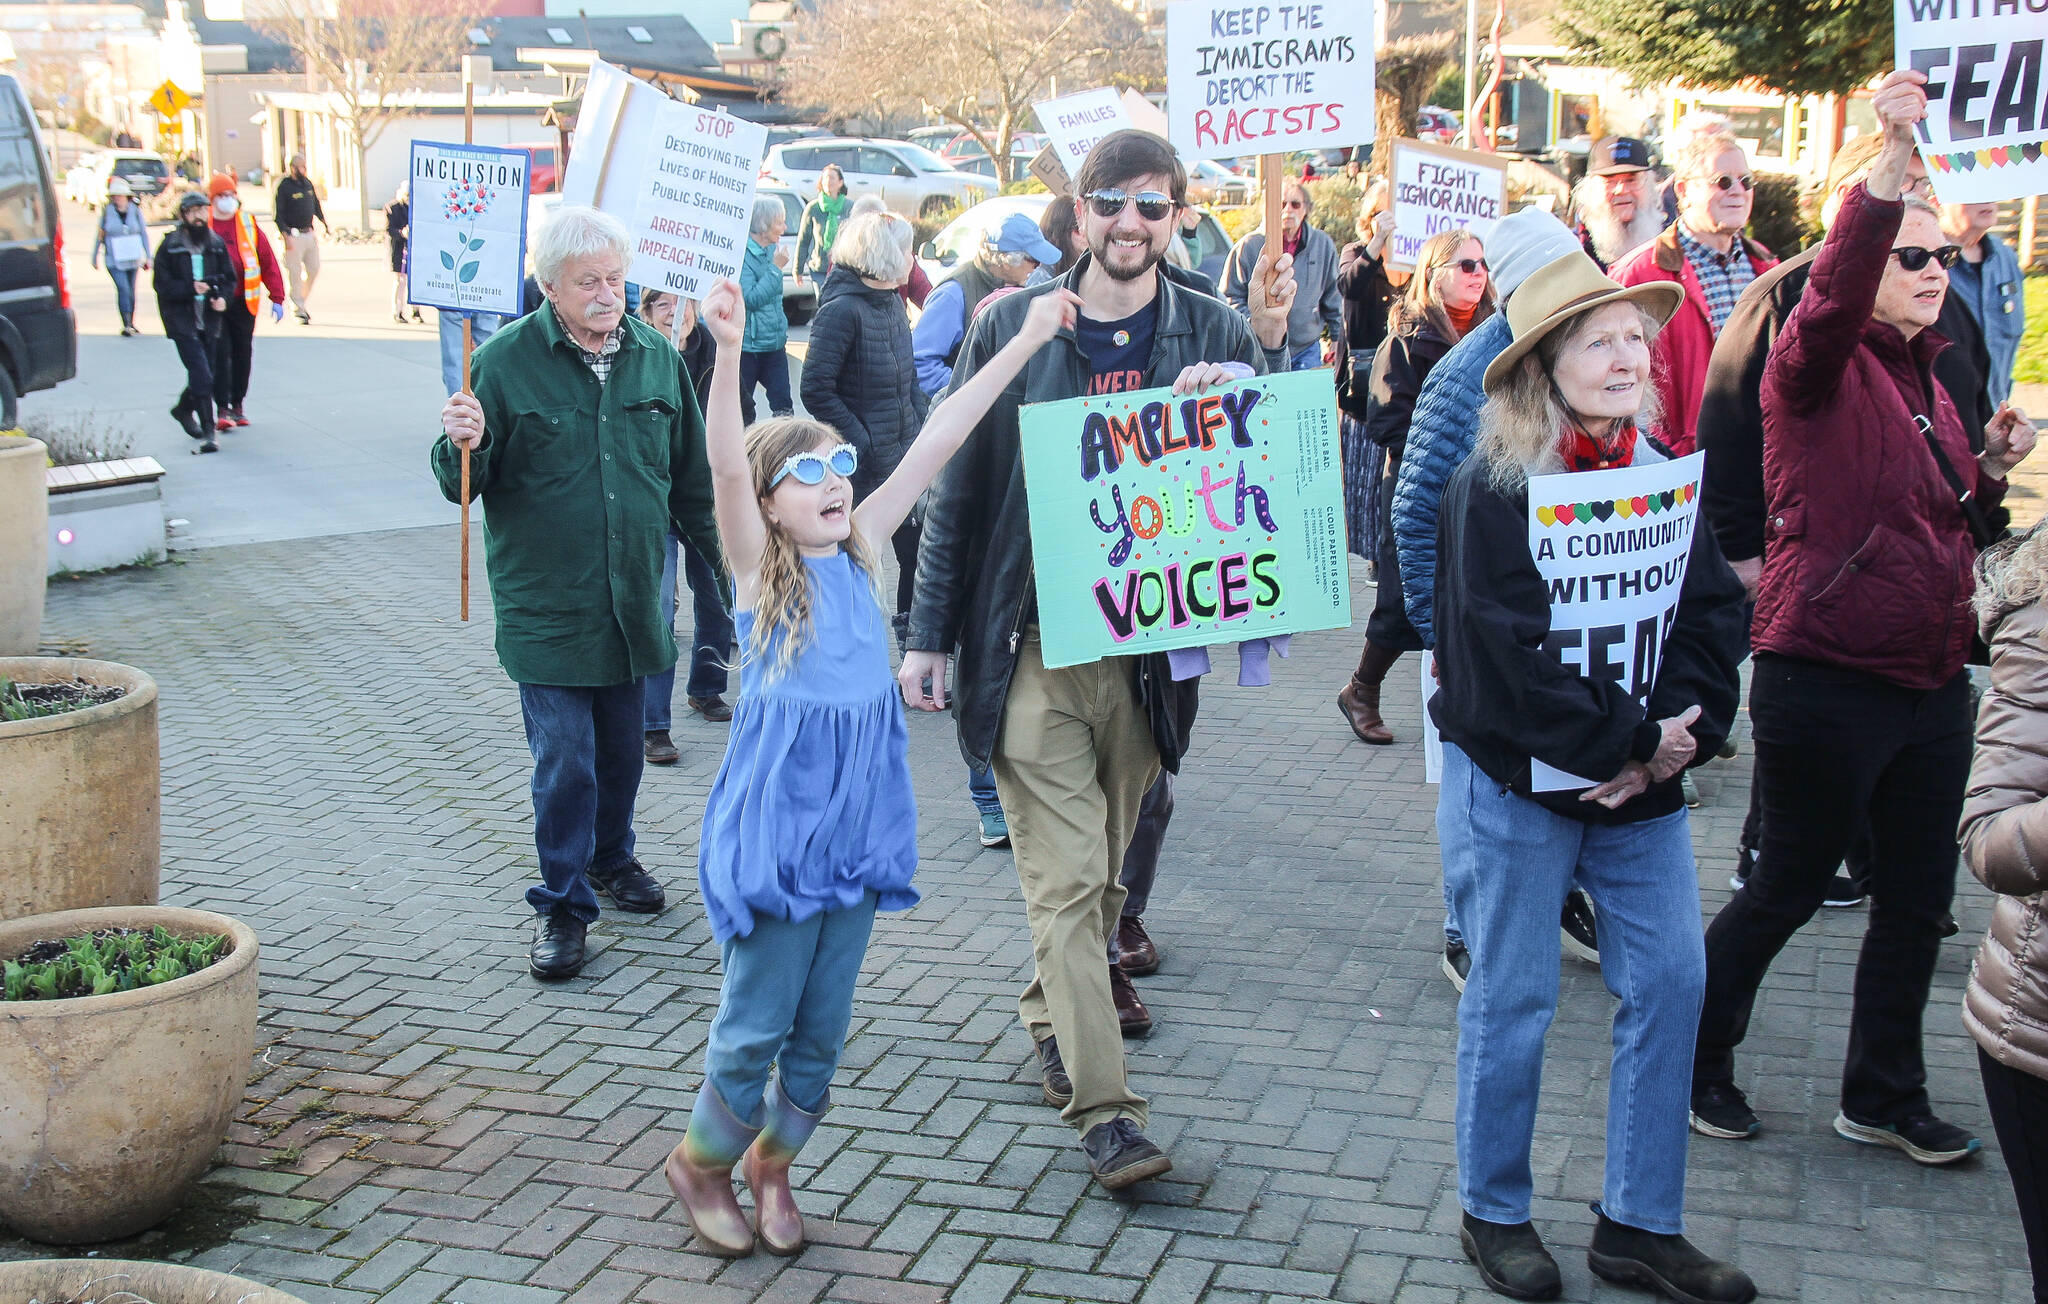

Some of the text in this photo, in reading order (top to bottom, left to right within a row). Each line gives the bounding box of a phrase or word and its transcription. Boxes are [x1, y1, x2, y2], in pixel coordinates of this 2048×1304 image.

[1211, 5, 1323, 38] KEEP THE
[1196, 36, 1355, 76] IMMIGRANTS
[1206, 71, 1315, 106] DEPORT THE
[1910, 39, 2048, 143] FEA
[695, 114, 735, 139] STOP
[1058, 105, 1117, 129] FAMILIES
[1195, 103, 1344, 149] RACISTS
[665, 135, 752, 171] DESTROYING THE
[416, 157, 521, 187] INCLUSION
[659, 158, 747, 194] LIVES OF HONEST
[1418, 162, 1480, 191] FIGHT
[652, 181, 745, 220] PUBLIC SERVANTS
[1397, 182, 1499, 219] IGNORANCE
[650, 216, 734, 251] ARREST MUSK
[638, 237, 735, 278] IMPEACH TRUMP
[426, 280, 454, 290] welcome
[470, 285, 502, 296] celebrate
[664, 271, 698, 293] NOW
[1081, 389, 1261, 482] AMPLIFY
[1320, 408, 1328, 435] PAPER
[1321, 439, 1328, 448] IS
[1089, 460, 1279, 567] youth
[1327, 506, 1335, 536] CLOUD
[1329, 539, 1337, 566] PAPER
[1537, 512, 1693, 561] A COMMUNITY
[1331, 569, 1337, 577] IS
[1549, 551, 1687, 605] WITHOUT
[1092, 549, 1283, 642] VOICES
